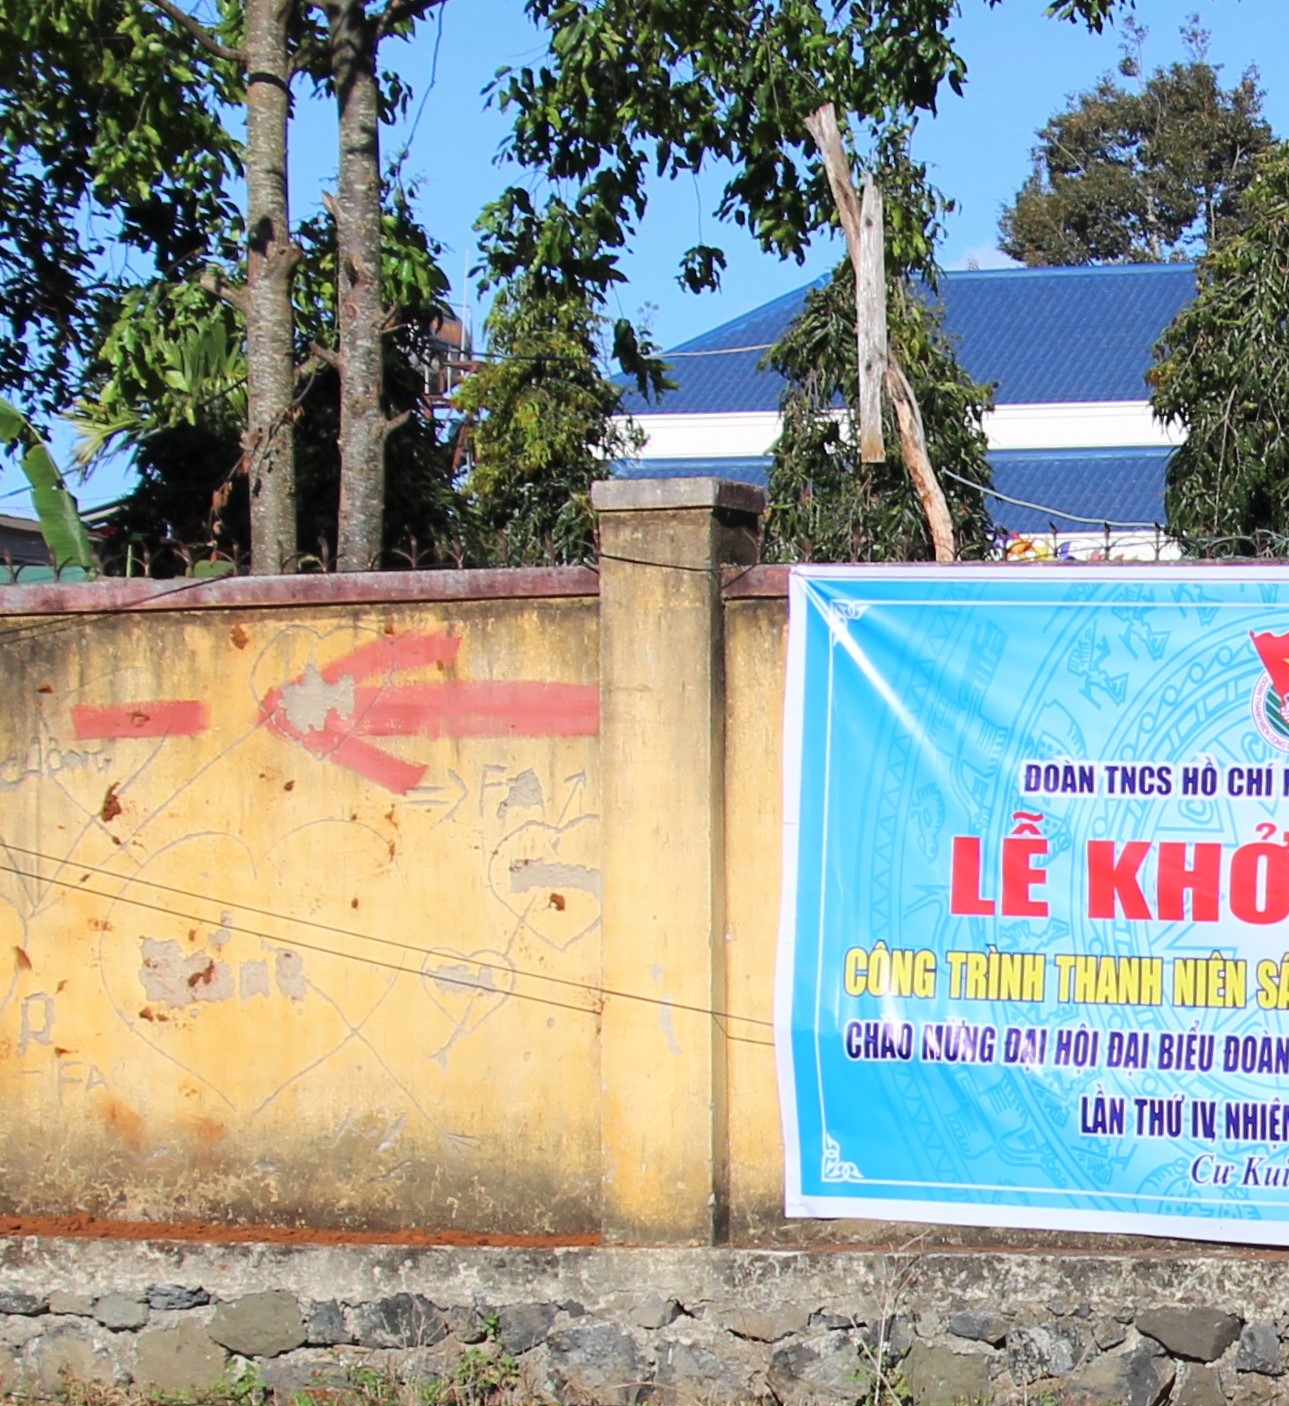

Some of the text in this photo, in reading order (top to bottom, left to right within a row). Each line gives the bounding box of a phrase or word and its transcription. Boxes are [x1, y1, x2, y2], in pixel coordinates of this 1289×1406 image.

[1024, 760, 1094, 794] ĐOÀN
[1105, 765, 1172, 796] TNCS
[1182, 757, 1217, 797] HỒ
[1228, 763, 1273, 797] CHÍ
[951, 811, 1049, 918] LỄ
[844, 940, 937, 999] CÔNG
[947, 944, 1046, 1002] TRÌNH
[1055, 954, 1163, 1006] THANH
[1173, 950, 1247, 1009] NIÊN
[846, 1016, 914, 1060] CHÀO
[1003, 1027, 1047, 1072] ĐẠI
[1054, 1024, 1099, 1074] HỘI
[1106, 1031, 1150, 1076] ĐẠI
[1158, 1020, 1215, 1072] BIỂU
[1081, 1084, 1125, 1135] LẦN
[1134, 1094, 1185, 1138] THỨ
[1191, 1153, 1235, 1185] Cư
